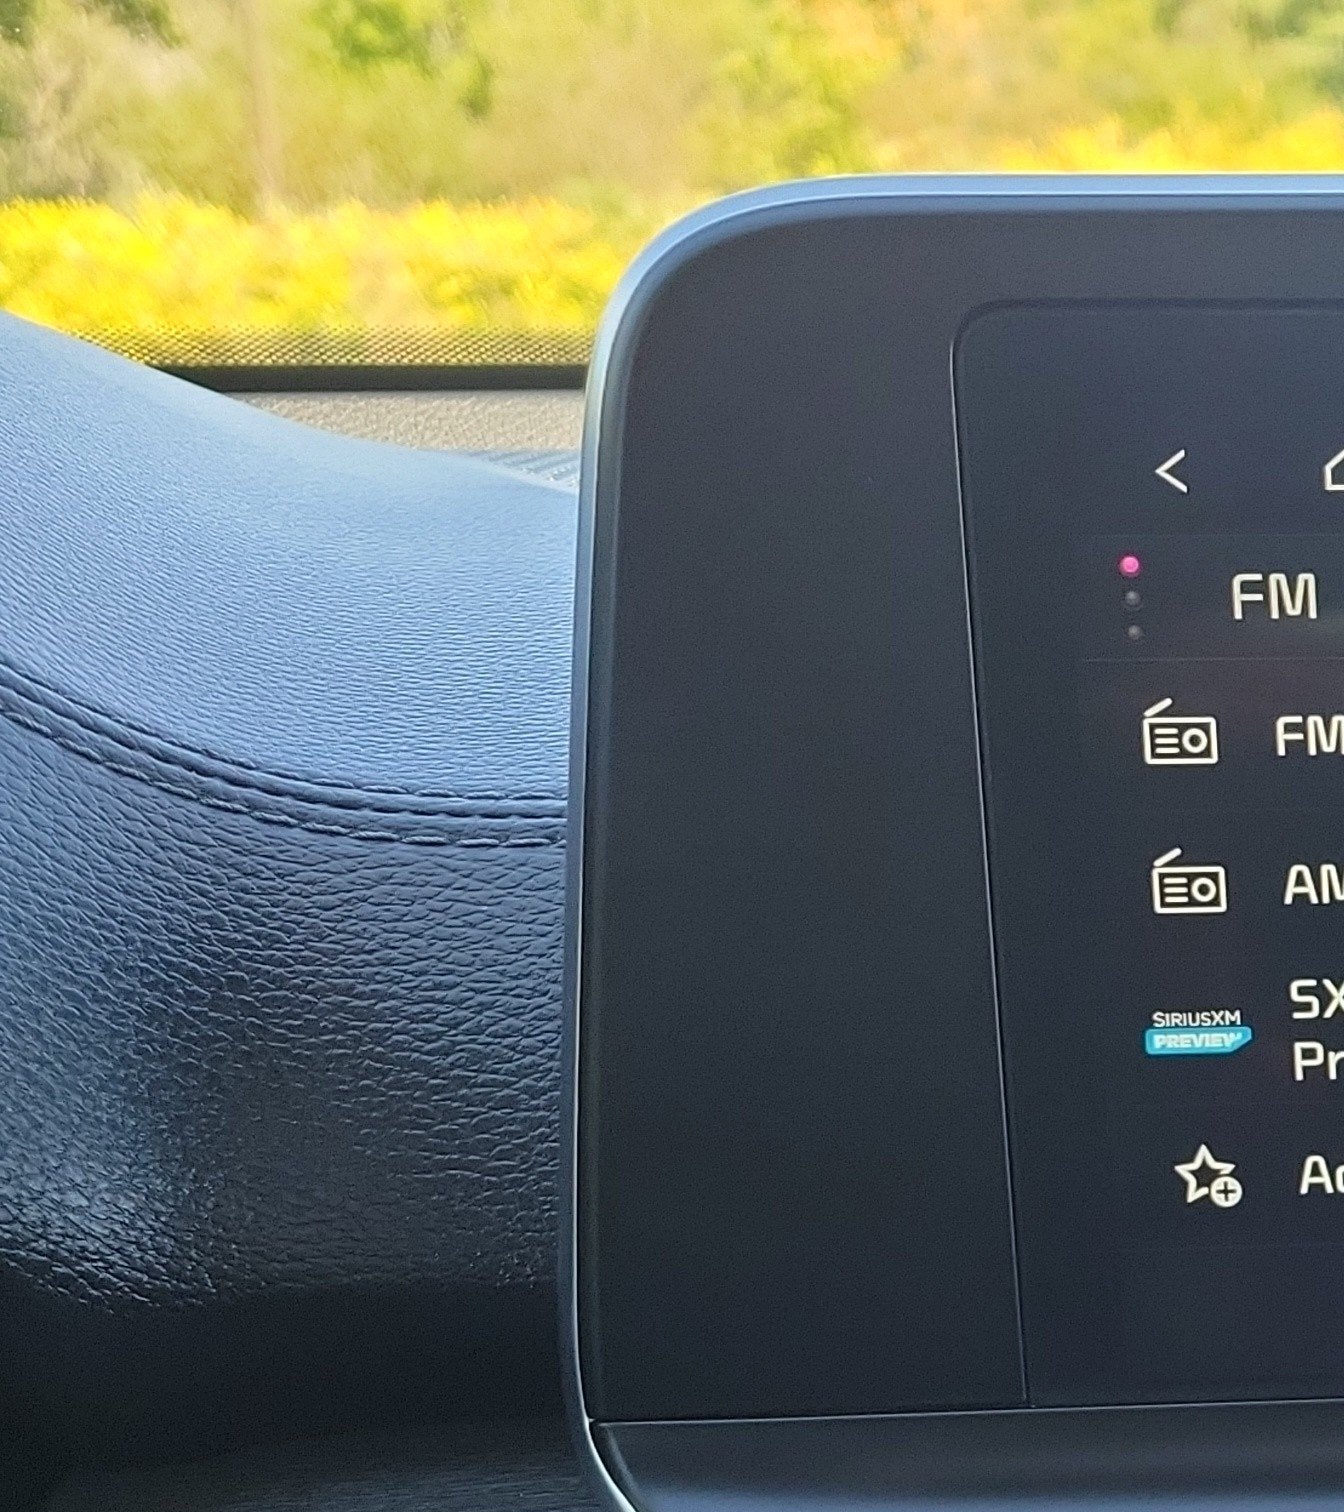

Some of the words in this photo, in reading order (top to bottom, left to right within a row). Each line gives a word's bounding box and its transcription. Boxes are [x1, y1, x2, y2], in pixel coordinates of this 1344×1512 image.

[1231, 573, 1318, 620] FM
[1151, 1010, 1241, 1028] SIRIUSXM
[1153, 1032, 1243, 1050] PREVIEW
